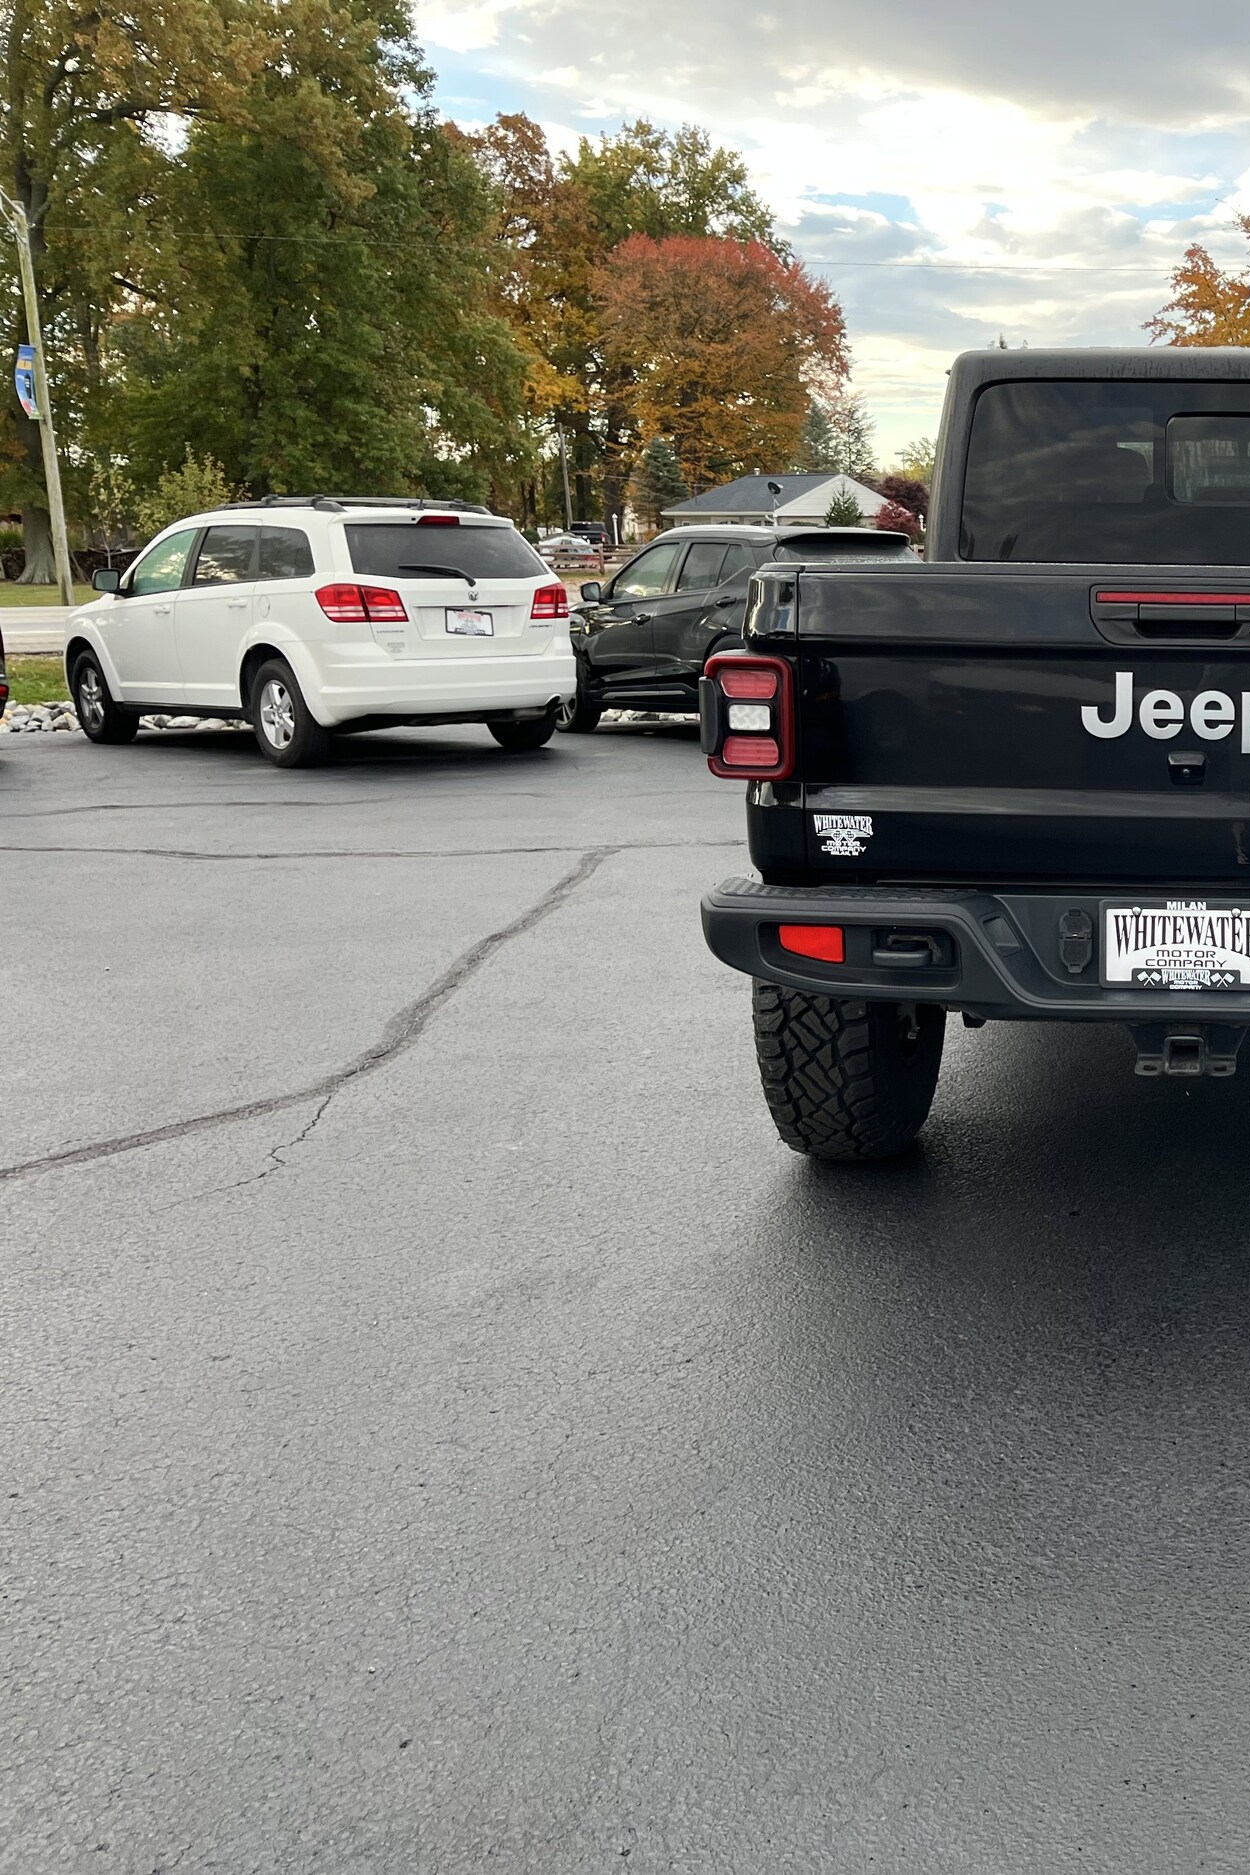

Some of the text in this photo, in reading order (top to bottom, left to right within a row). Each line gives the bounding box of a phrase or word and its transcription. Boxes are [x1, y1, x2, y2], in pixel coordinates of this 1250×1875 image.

[813, 814, 874, 836] WHITEWATER
[821, 845, 867, 853] COMPANY
[1166, 901, 1207, 911] MILAN
[1156, 949, 1216, 958] MOTOR
[1145, 958, 1227, 968] COMPANY
[1161, 968, 1211, 987] WHITEWATER
